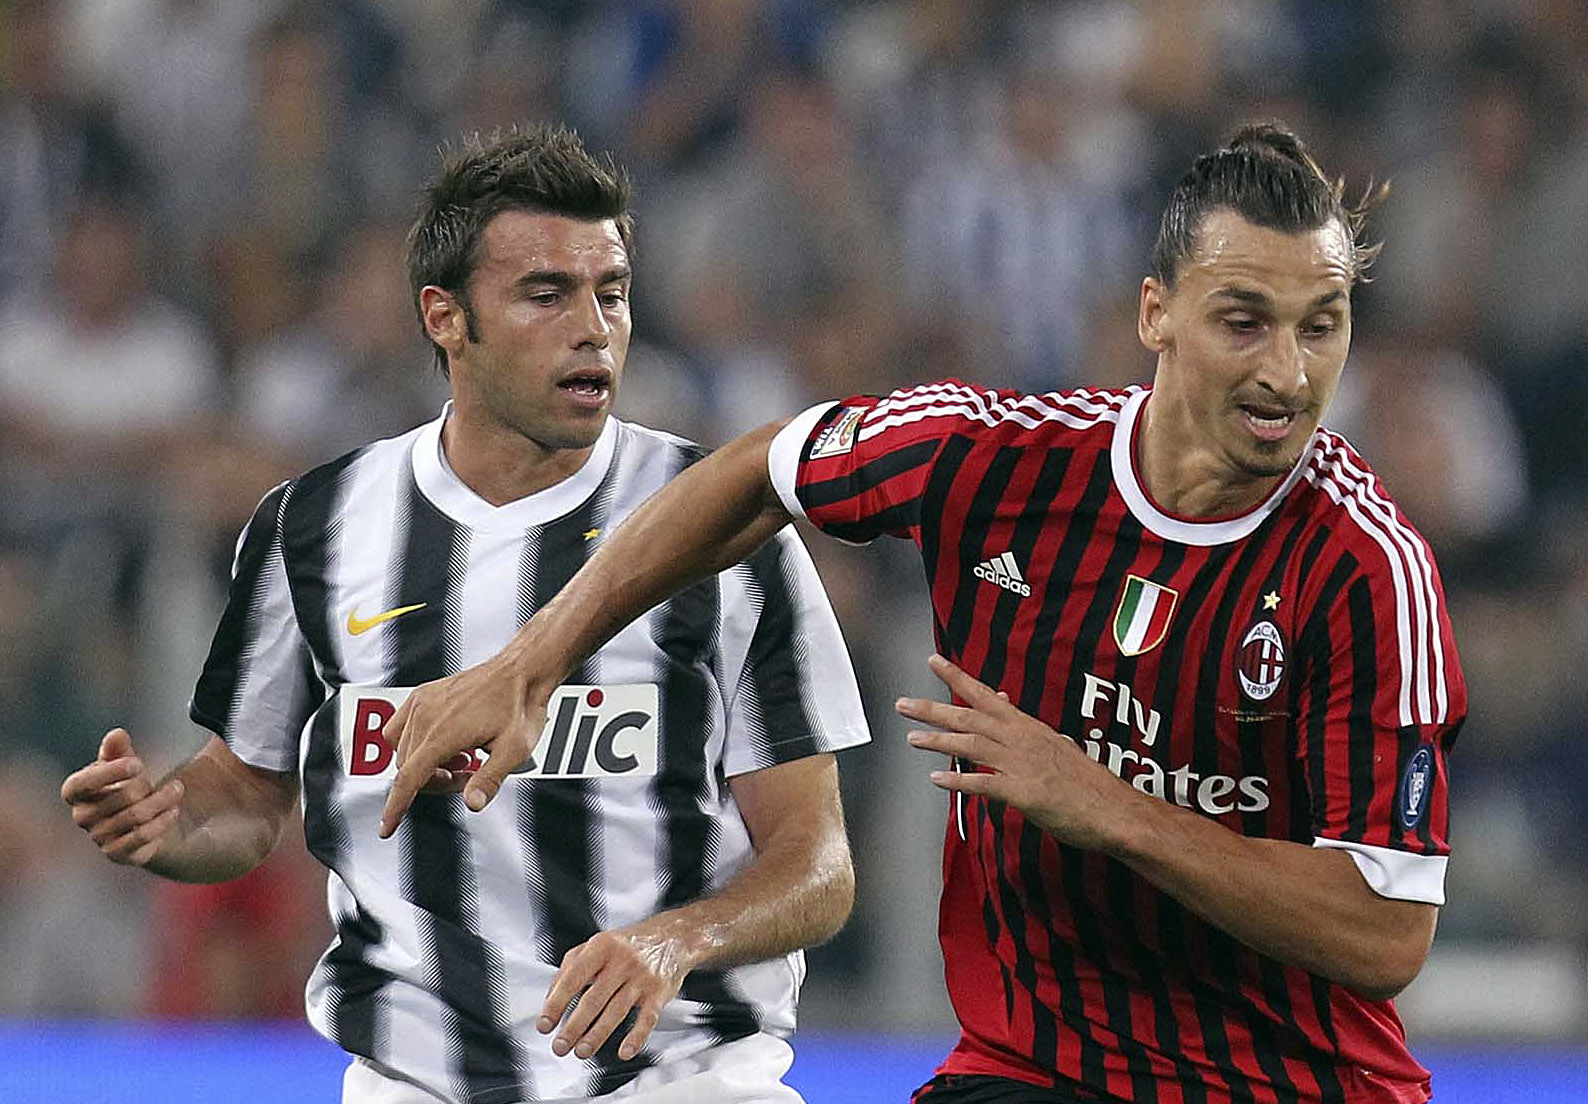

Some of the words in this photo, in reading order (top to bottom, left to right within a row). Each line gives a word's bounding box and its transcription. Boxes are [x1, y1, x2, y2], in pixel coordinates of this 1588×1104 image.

[973, 566, 1031, 597] adidas
[1252, 624, 1280, 642] ACM
[1081, 672, 1161, 747] Fly
[1246, 684, 1271, 695] 1899
[349, 687, 652, 776] Blic
[1060, 728, 1270, 814] irates
